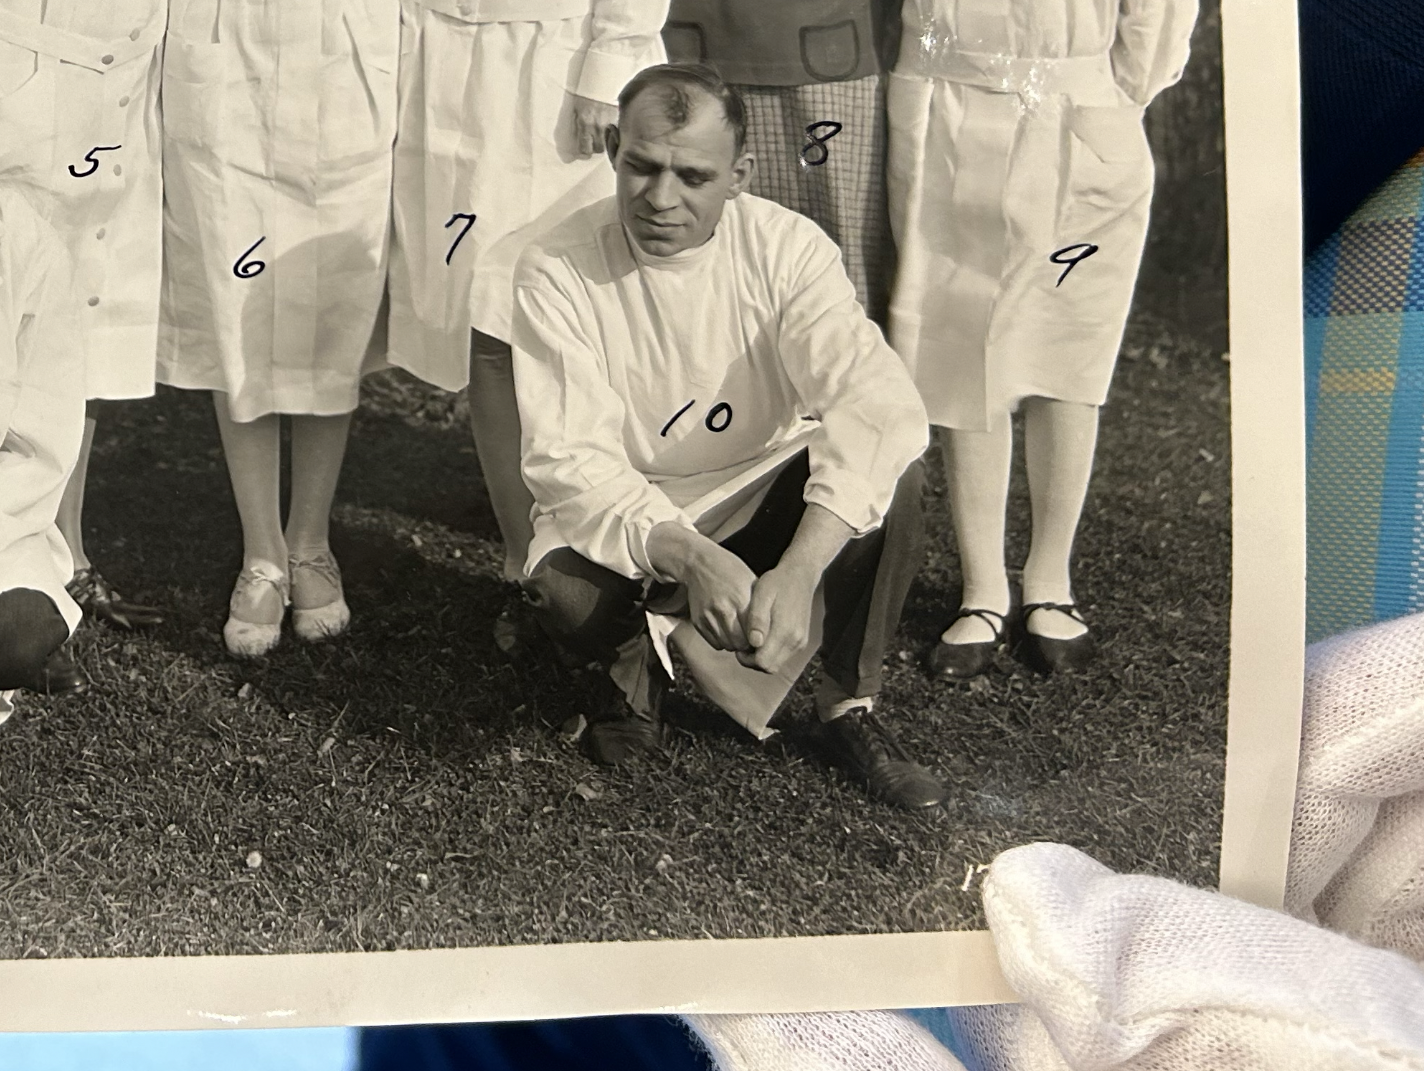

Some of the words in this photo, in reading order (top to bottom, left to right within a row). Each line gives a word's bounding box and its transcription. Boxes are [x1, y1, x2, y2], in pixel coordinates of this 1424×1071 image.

[67, 144, 123, 179] 5
[800, 120, 843, 166] 8
[232, 236, 267, 280] 6
[444, 213, 478, 267] 7
[1049, 243, 1100, 288] 9
[660, 400, 734, 438] 10
